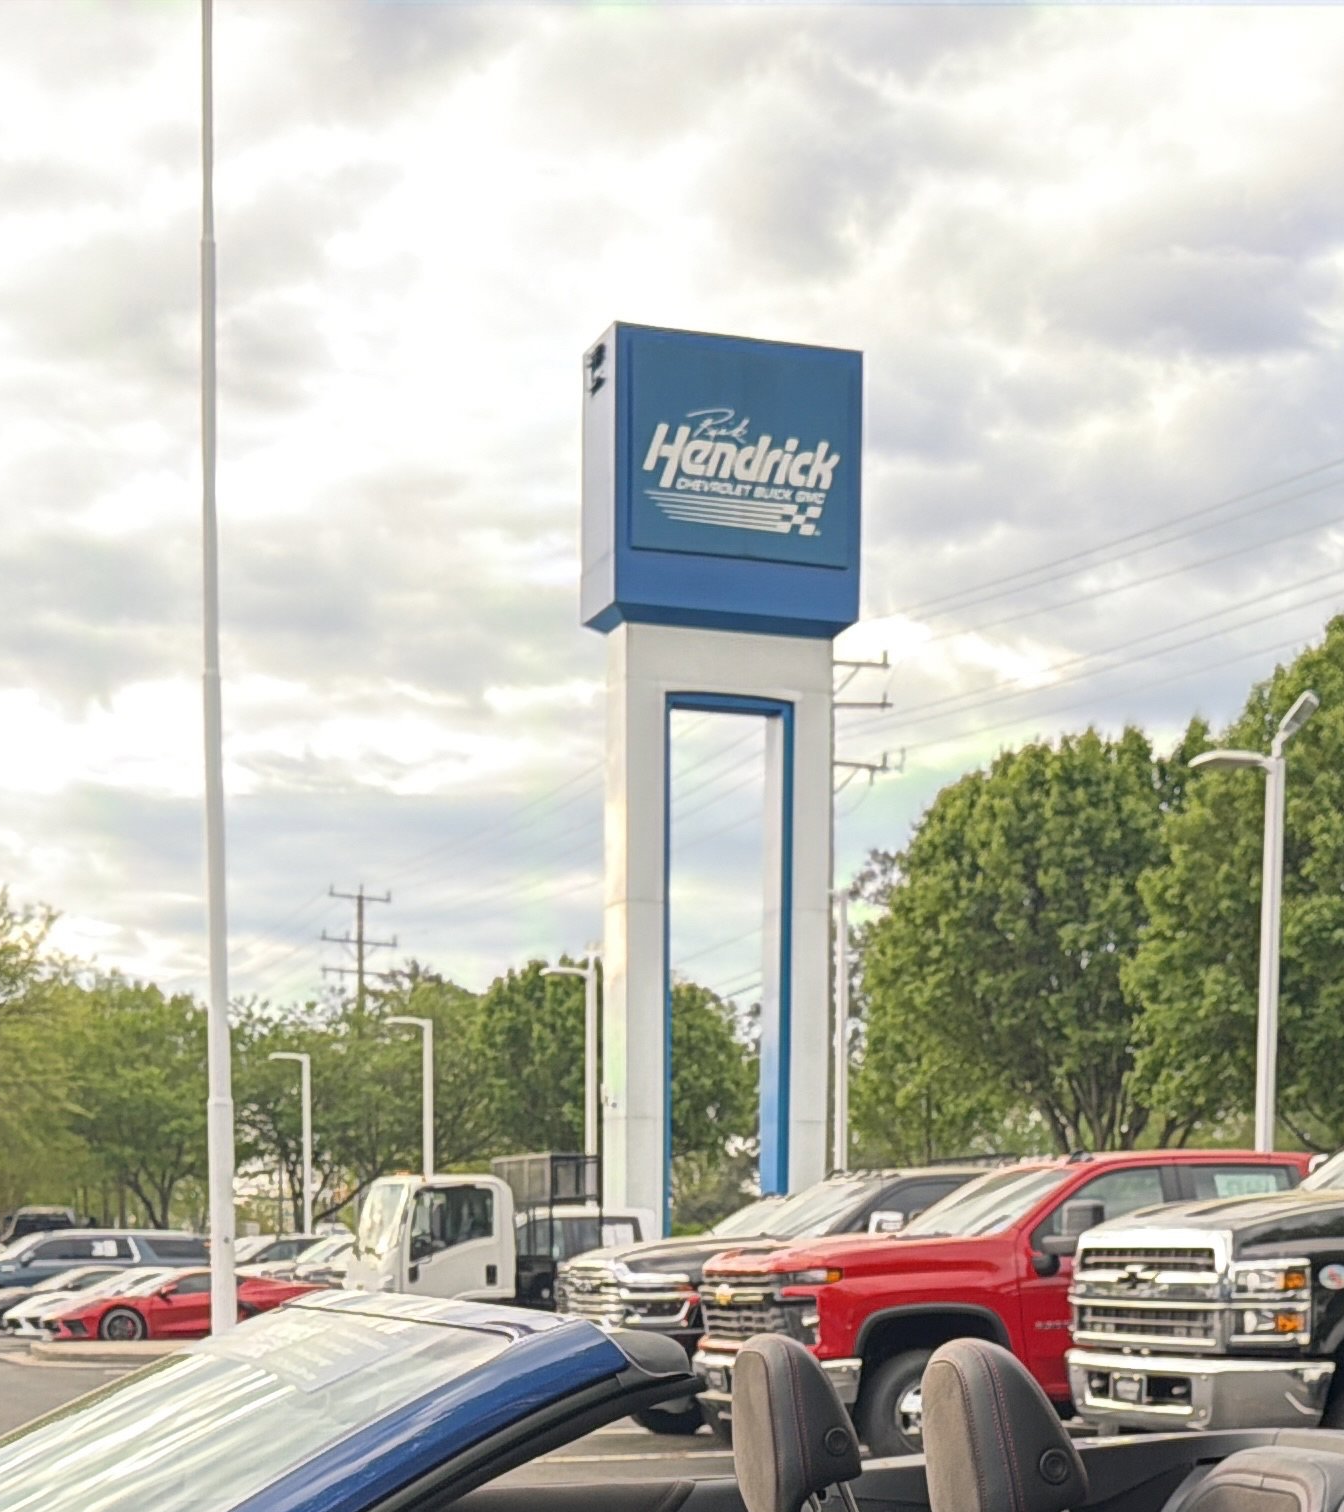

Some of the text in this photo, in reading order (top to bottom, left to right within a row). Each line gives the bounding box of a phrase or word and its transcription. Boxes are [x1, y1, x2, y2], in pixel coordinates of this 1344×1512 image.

[642, 423, 840, 489] Hendrick
[675, 476, 826, 504] CHEVROLET BUICK GMC
